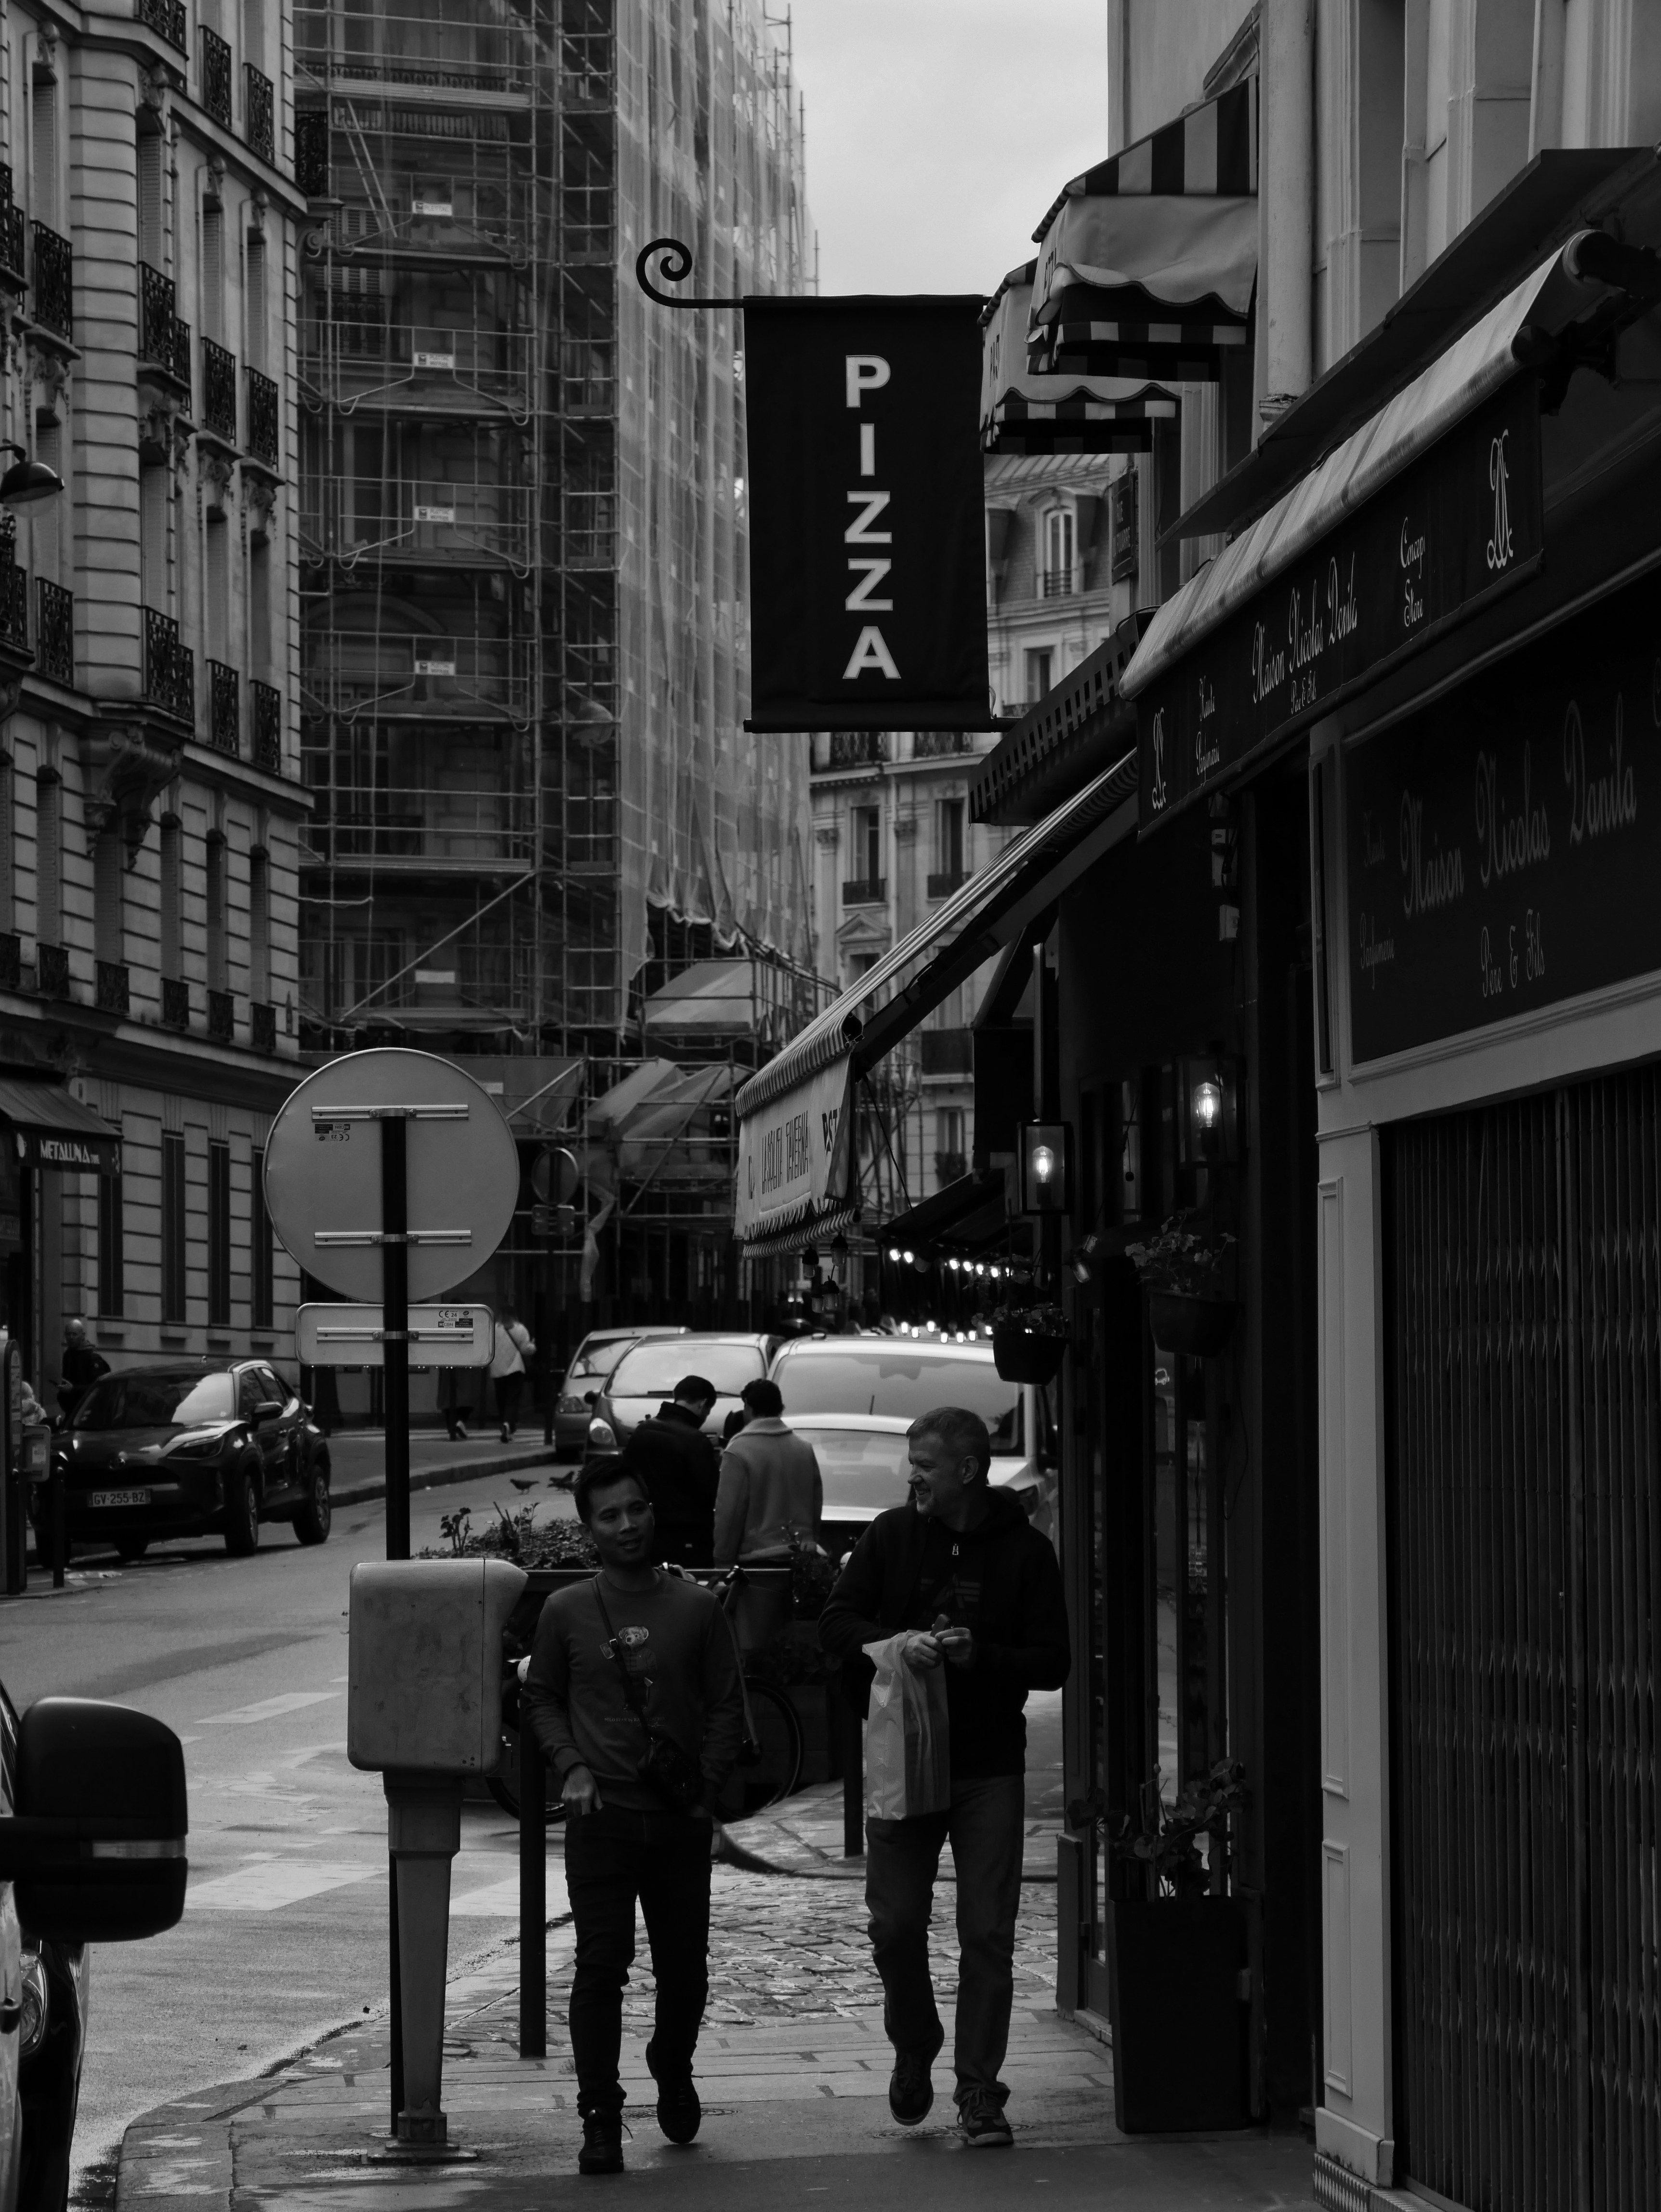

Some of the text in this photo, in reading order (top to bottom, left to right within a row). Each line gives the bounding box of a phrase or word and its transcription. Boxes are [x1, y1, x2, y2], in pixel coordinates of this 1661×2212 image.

[842, 354, 902, 679] PIZZA
[1252, 621, 1285, 704] Maison
[1289, 579, 1323, 673] Nicolas
[1404, 579, 1424, 627] Store
[1399, 788, 1464, 919] Maison
[1475, 738, 1550, 888] Nicolas
[1564, 691, 1637, 848] Danila
[1359, 912, 1395, 990] Parfumerie
[1481, 908, 1545, 998] Père & Fils
[786, 1110, 808, 1184] TAVERNA
[94, 1492, 144, 1505] GV-255-BZ
